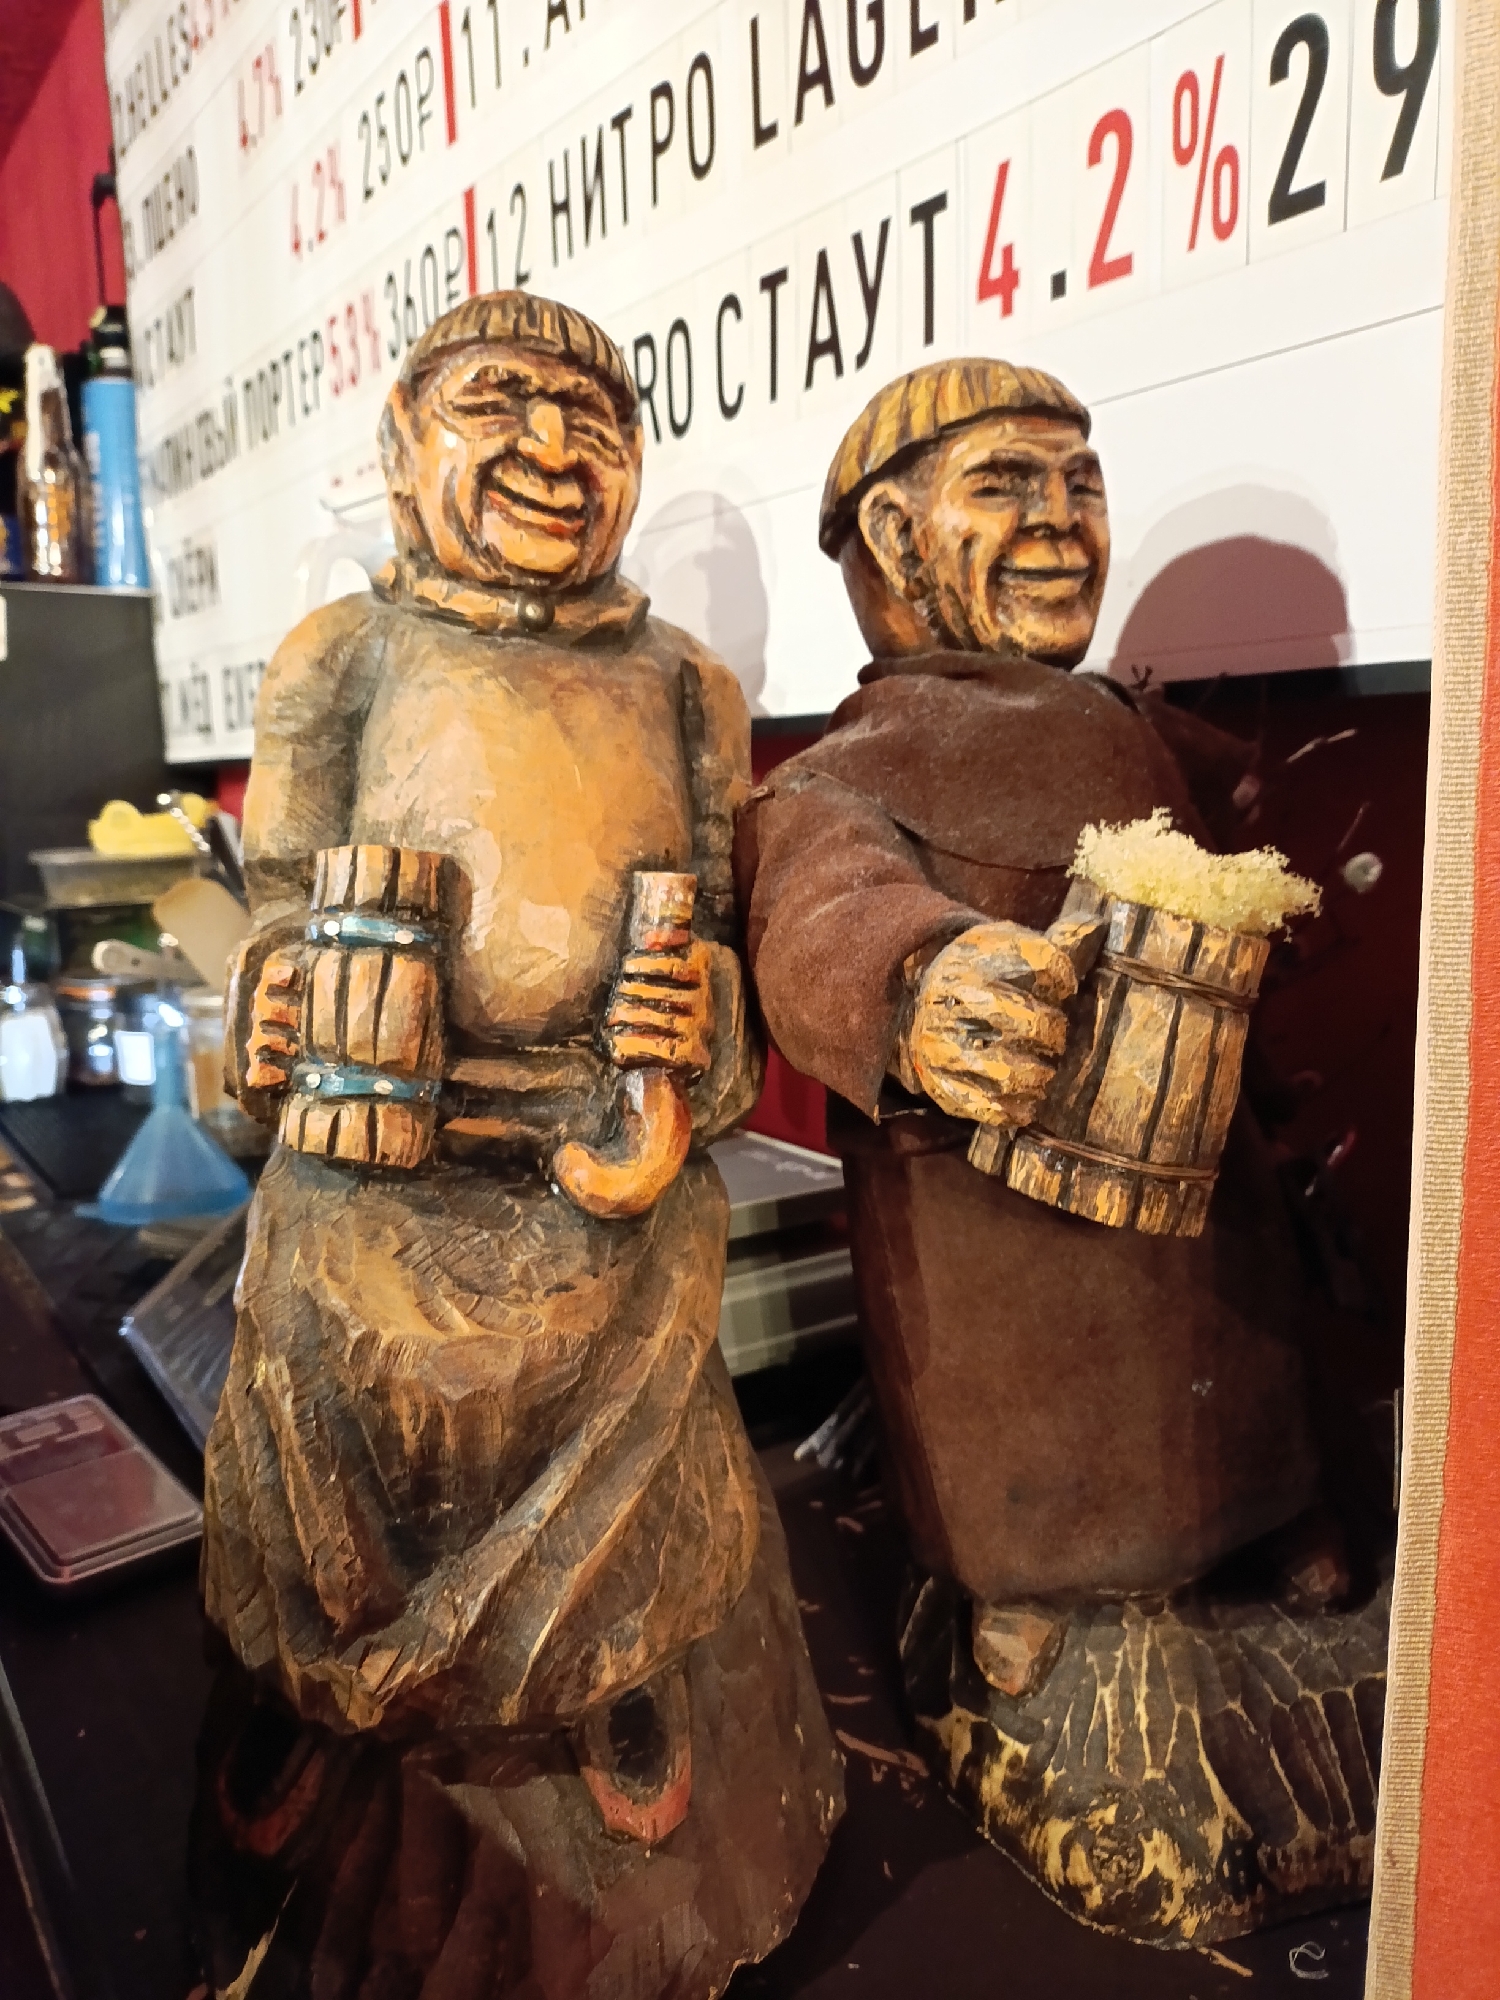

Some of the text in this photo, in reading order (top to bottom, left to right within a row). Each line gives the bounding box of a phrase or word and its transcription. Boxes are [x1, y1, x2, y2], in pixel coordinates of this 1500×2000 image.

[548, 51, 717, 268] НИТРО
[715, 189, 949, 422] СТАУТ
[976, 54, 1241, 318] 4.2%
